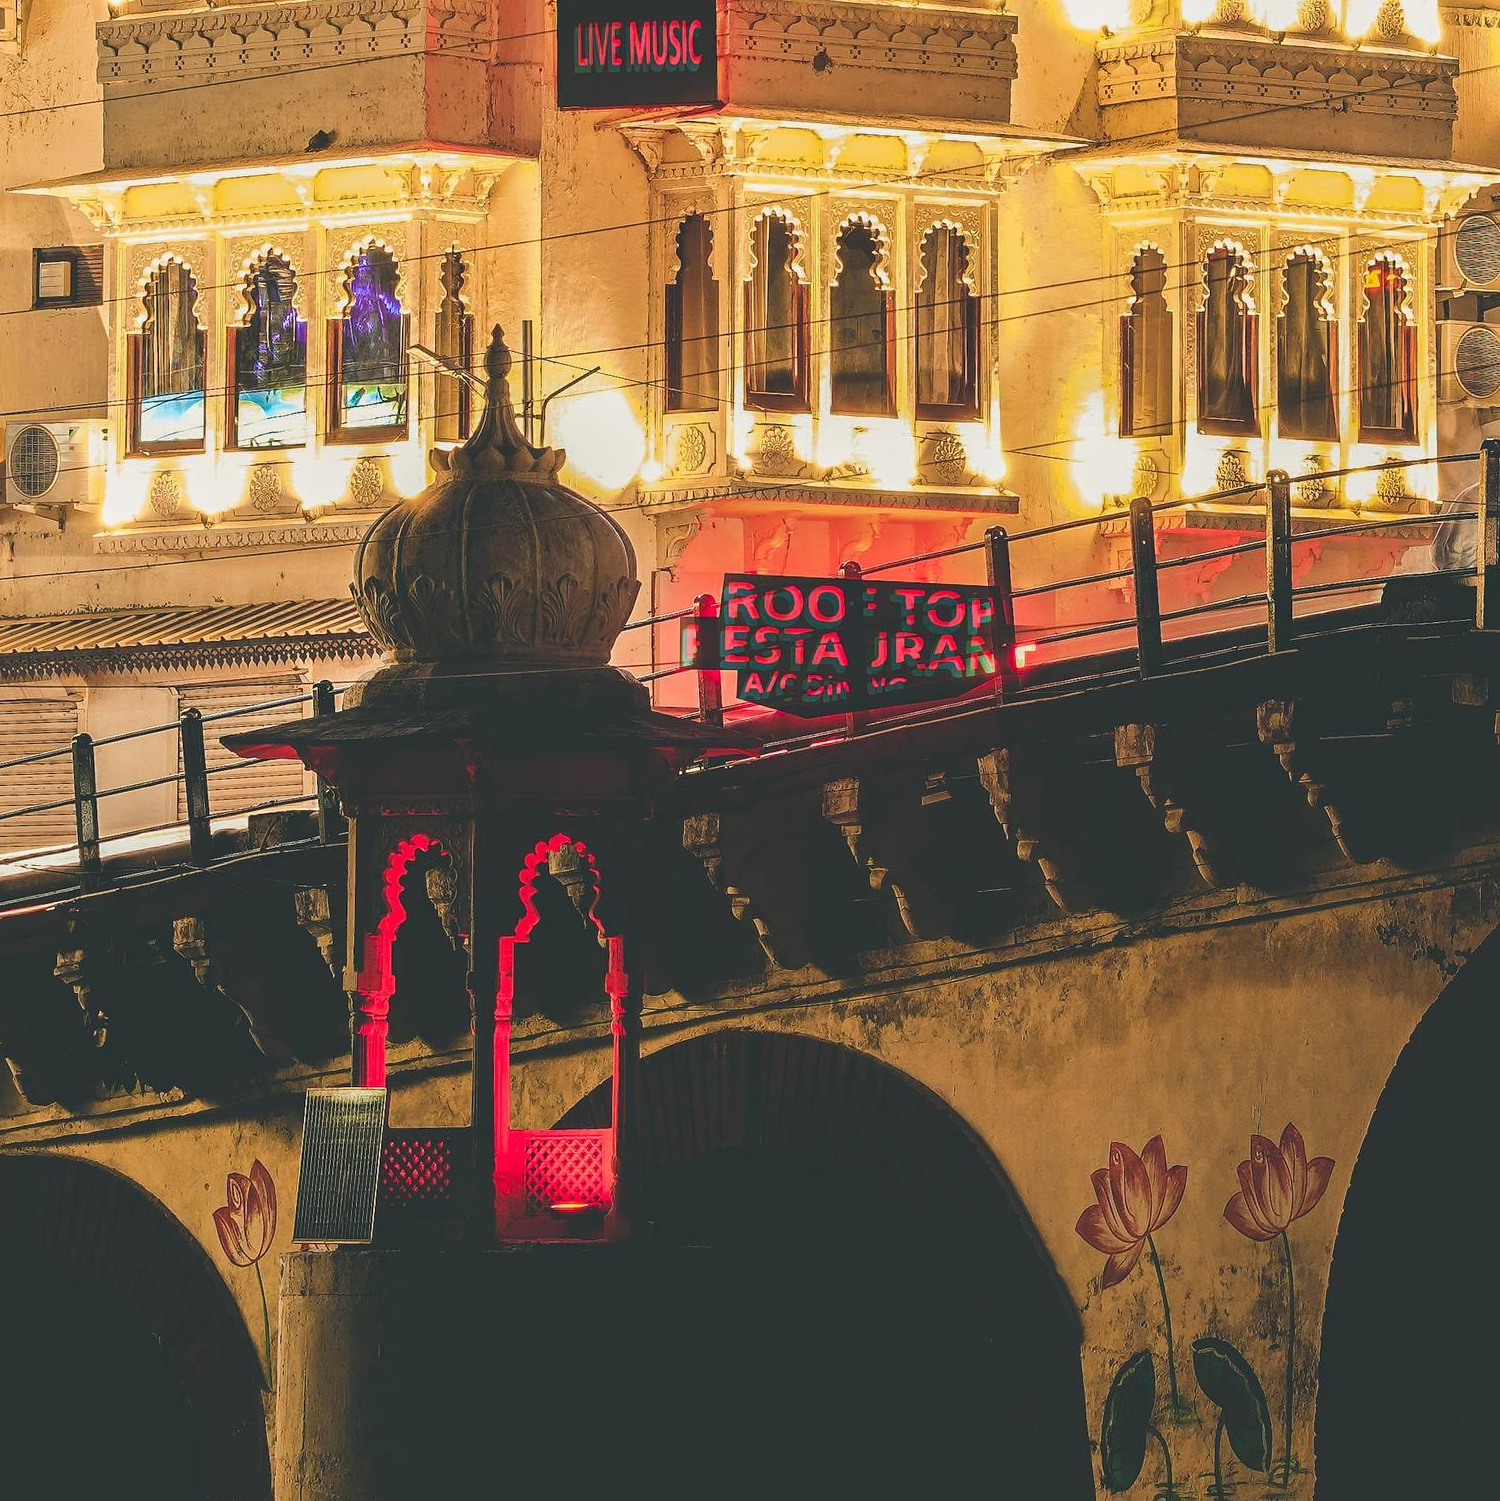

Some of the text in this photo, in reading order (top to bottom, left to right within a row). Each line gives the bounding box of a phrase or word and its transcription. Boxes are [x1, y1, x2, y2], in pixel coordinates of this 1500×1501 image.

[577, 19, 702, 67] LIVE MUSIC
[727, 581, 877, 623] ROO
